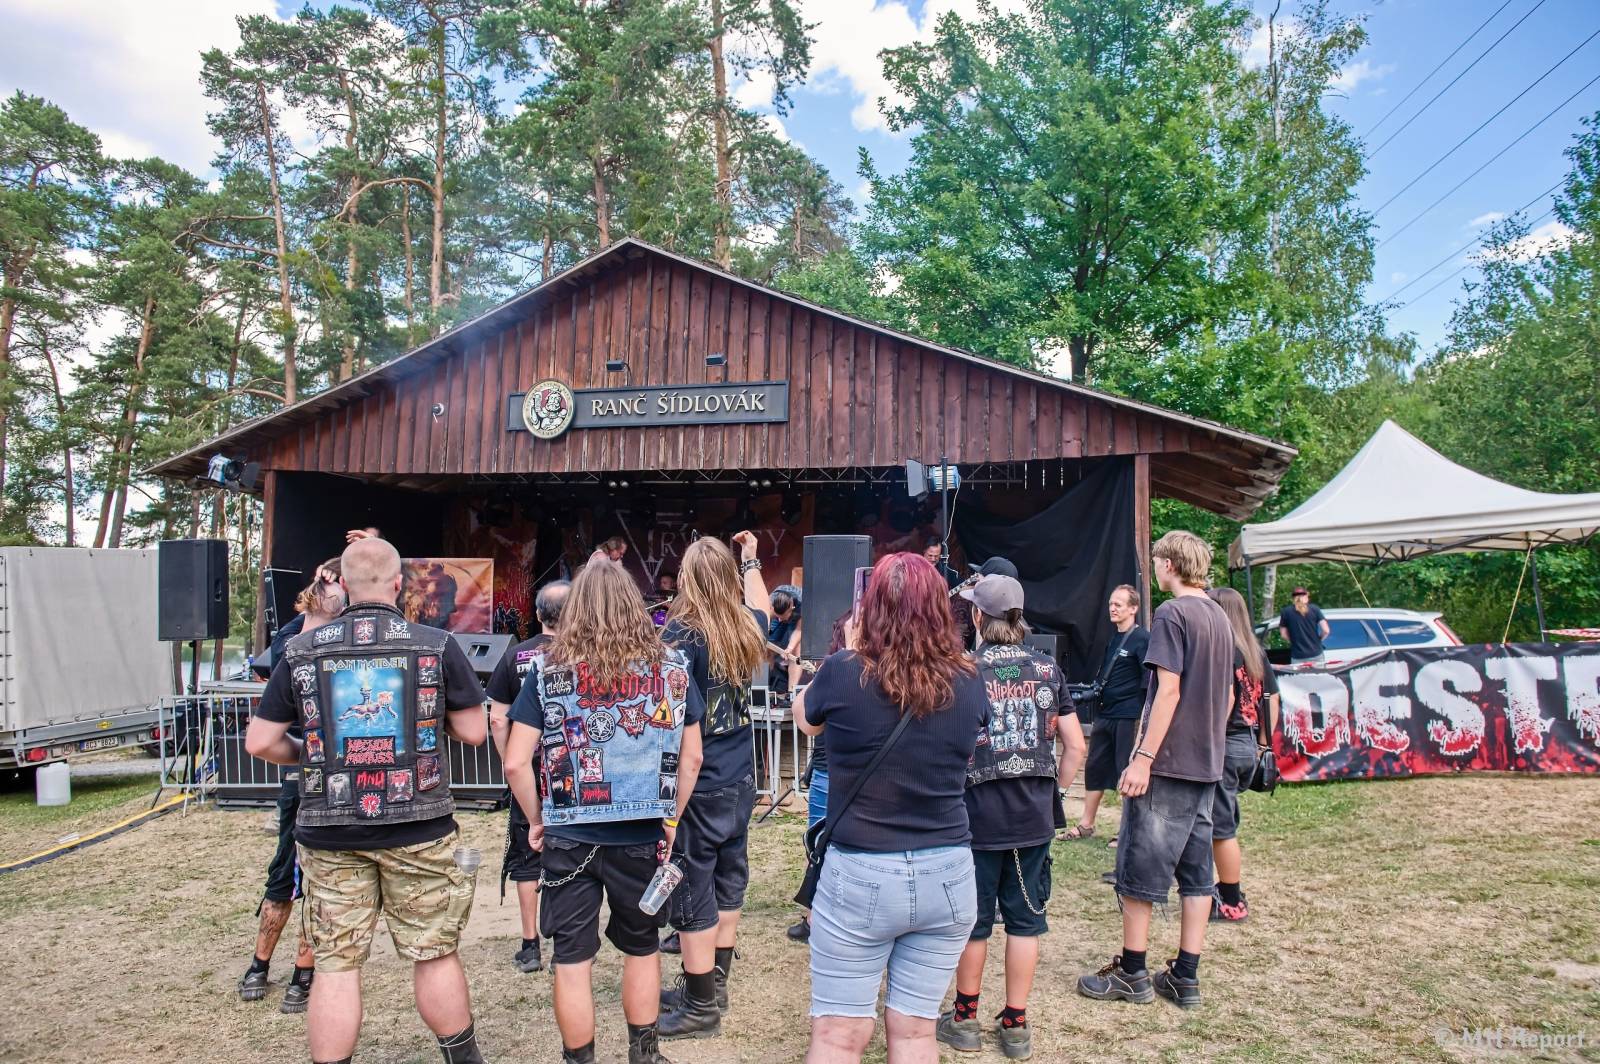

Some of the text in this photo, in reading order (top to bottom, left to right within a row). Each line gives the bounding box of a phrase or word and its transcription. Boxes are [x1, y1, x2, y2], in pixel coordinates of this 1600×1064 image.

[591, 393, 647, 416] RANČ
[657, 390, 766, 414] ŠÍDLOVÁK
[323, 656, 408, 673] IRON MAIDEN
